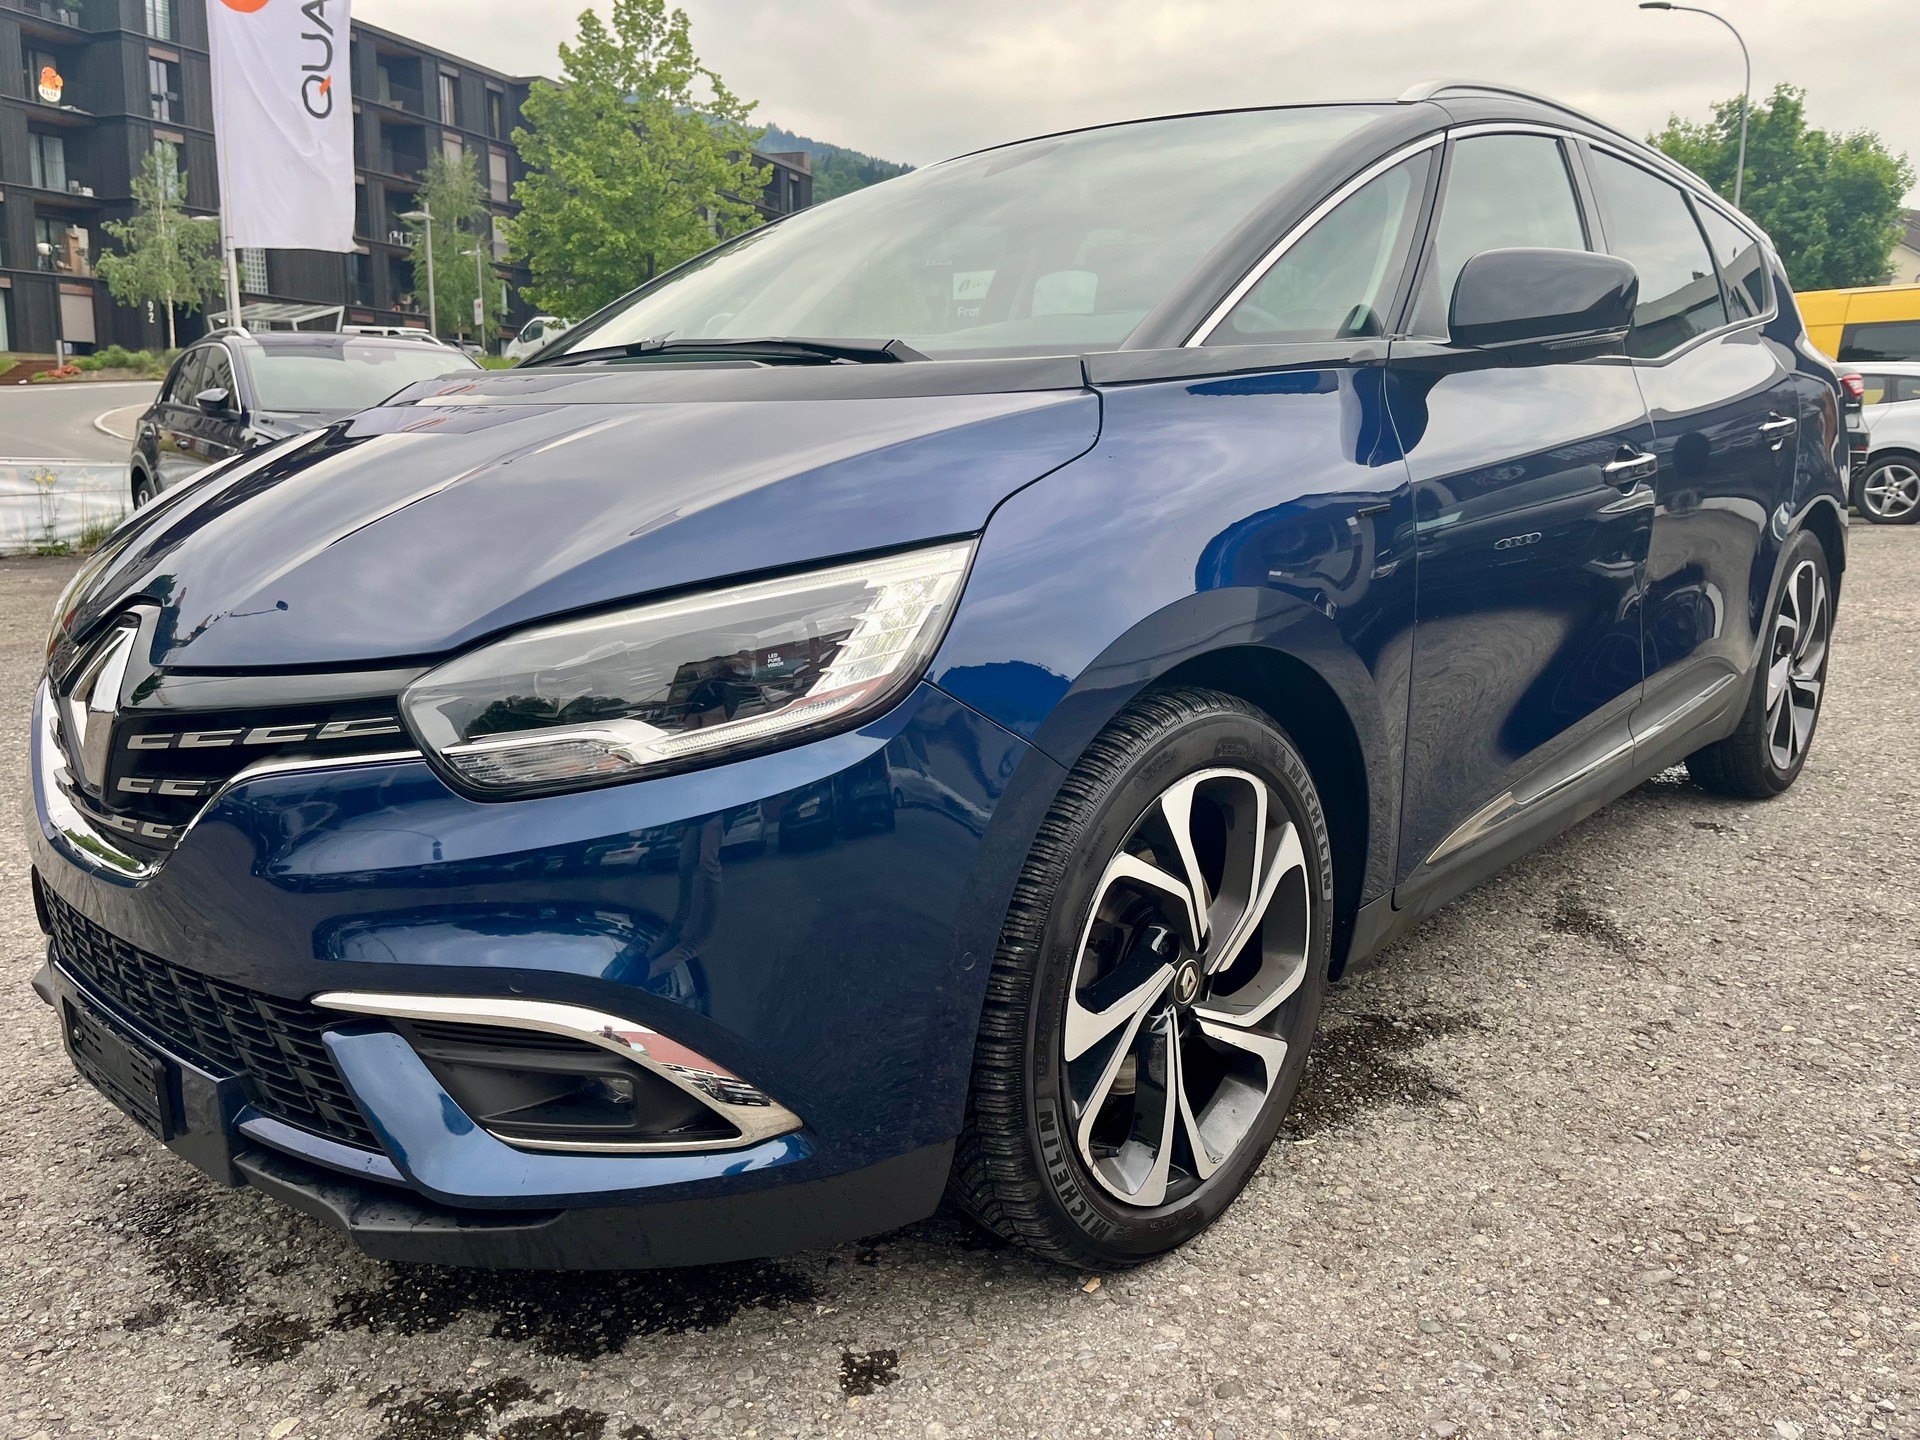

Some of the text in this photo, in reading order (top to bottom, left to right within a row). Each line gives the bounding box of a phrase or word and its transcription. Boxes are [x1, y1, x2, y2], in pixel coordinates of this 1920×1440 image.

[147, 300, 155, 324] 92
[1288, 761, 1332, 891] MICHELIN
[1038, 1110, 1113, 1241] MICHELIN
